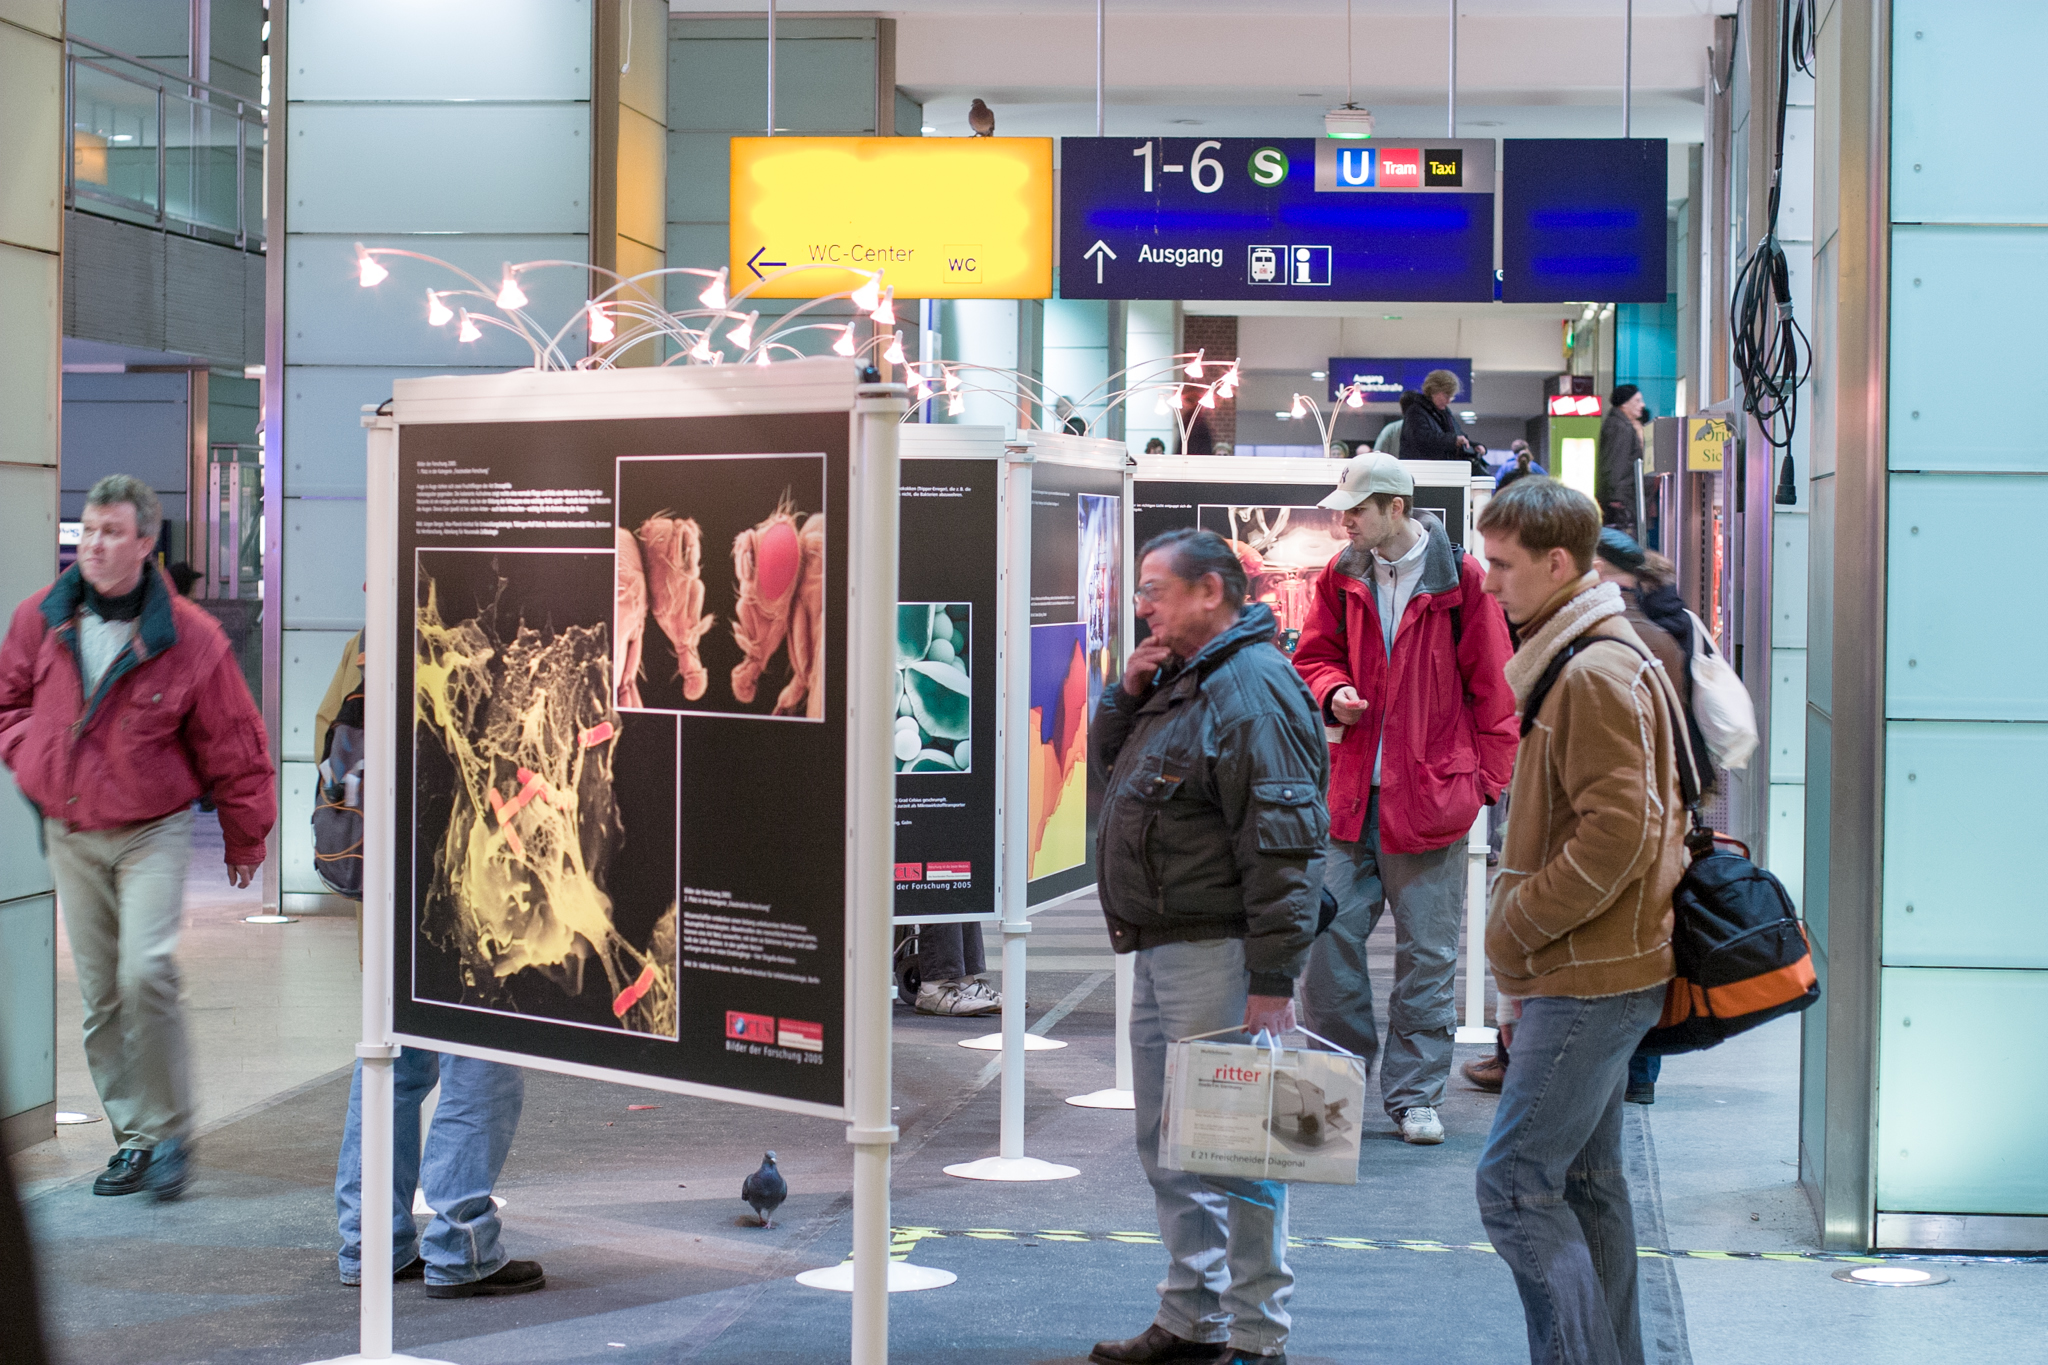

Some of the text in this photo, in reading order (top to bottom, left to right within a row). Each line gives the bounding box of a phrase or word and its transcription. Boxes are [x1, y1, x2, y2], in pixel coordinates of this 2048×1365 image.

[1254, 149, 1283, 185] S
[1342, 150, 1456, 185] U Tram Taxi
[808, 244, 914, 262] WC-Center
[1138, 244, 1223, 267] Ausgang
[948, 258, 977, 271] WC
[1703, 427, 1732, 442] Ori
[894, 866, 920, 879] CUS
[911, 882, 950, 890] Forschung
[952, 881, 972, 889] 2005
[725, 1040, 824, 1065] Bilder der Forschung 2005
[1215, 1063, 1262, 1083] ritter
[1198, 1151, 1208, 1160] 21
[1211, 1152, 1266, 1165] Freischneider
[1267, 1156, 1306, 1168] Diagonal
